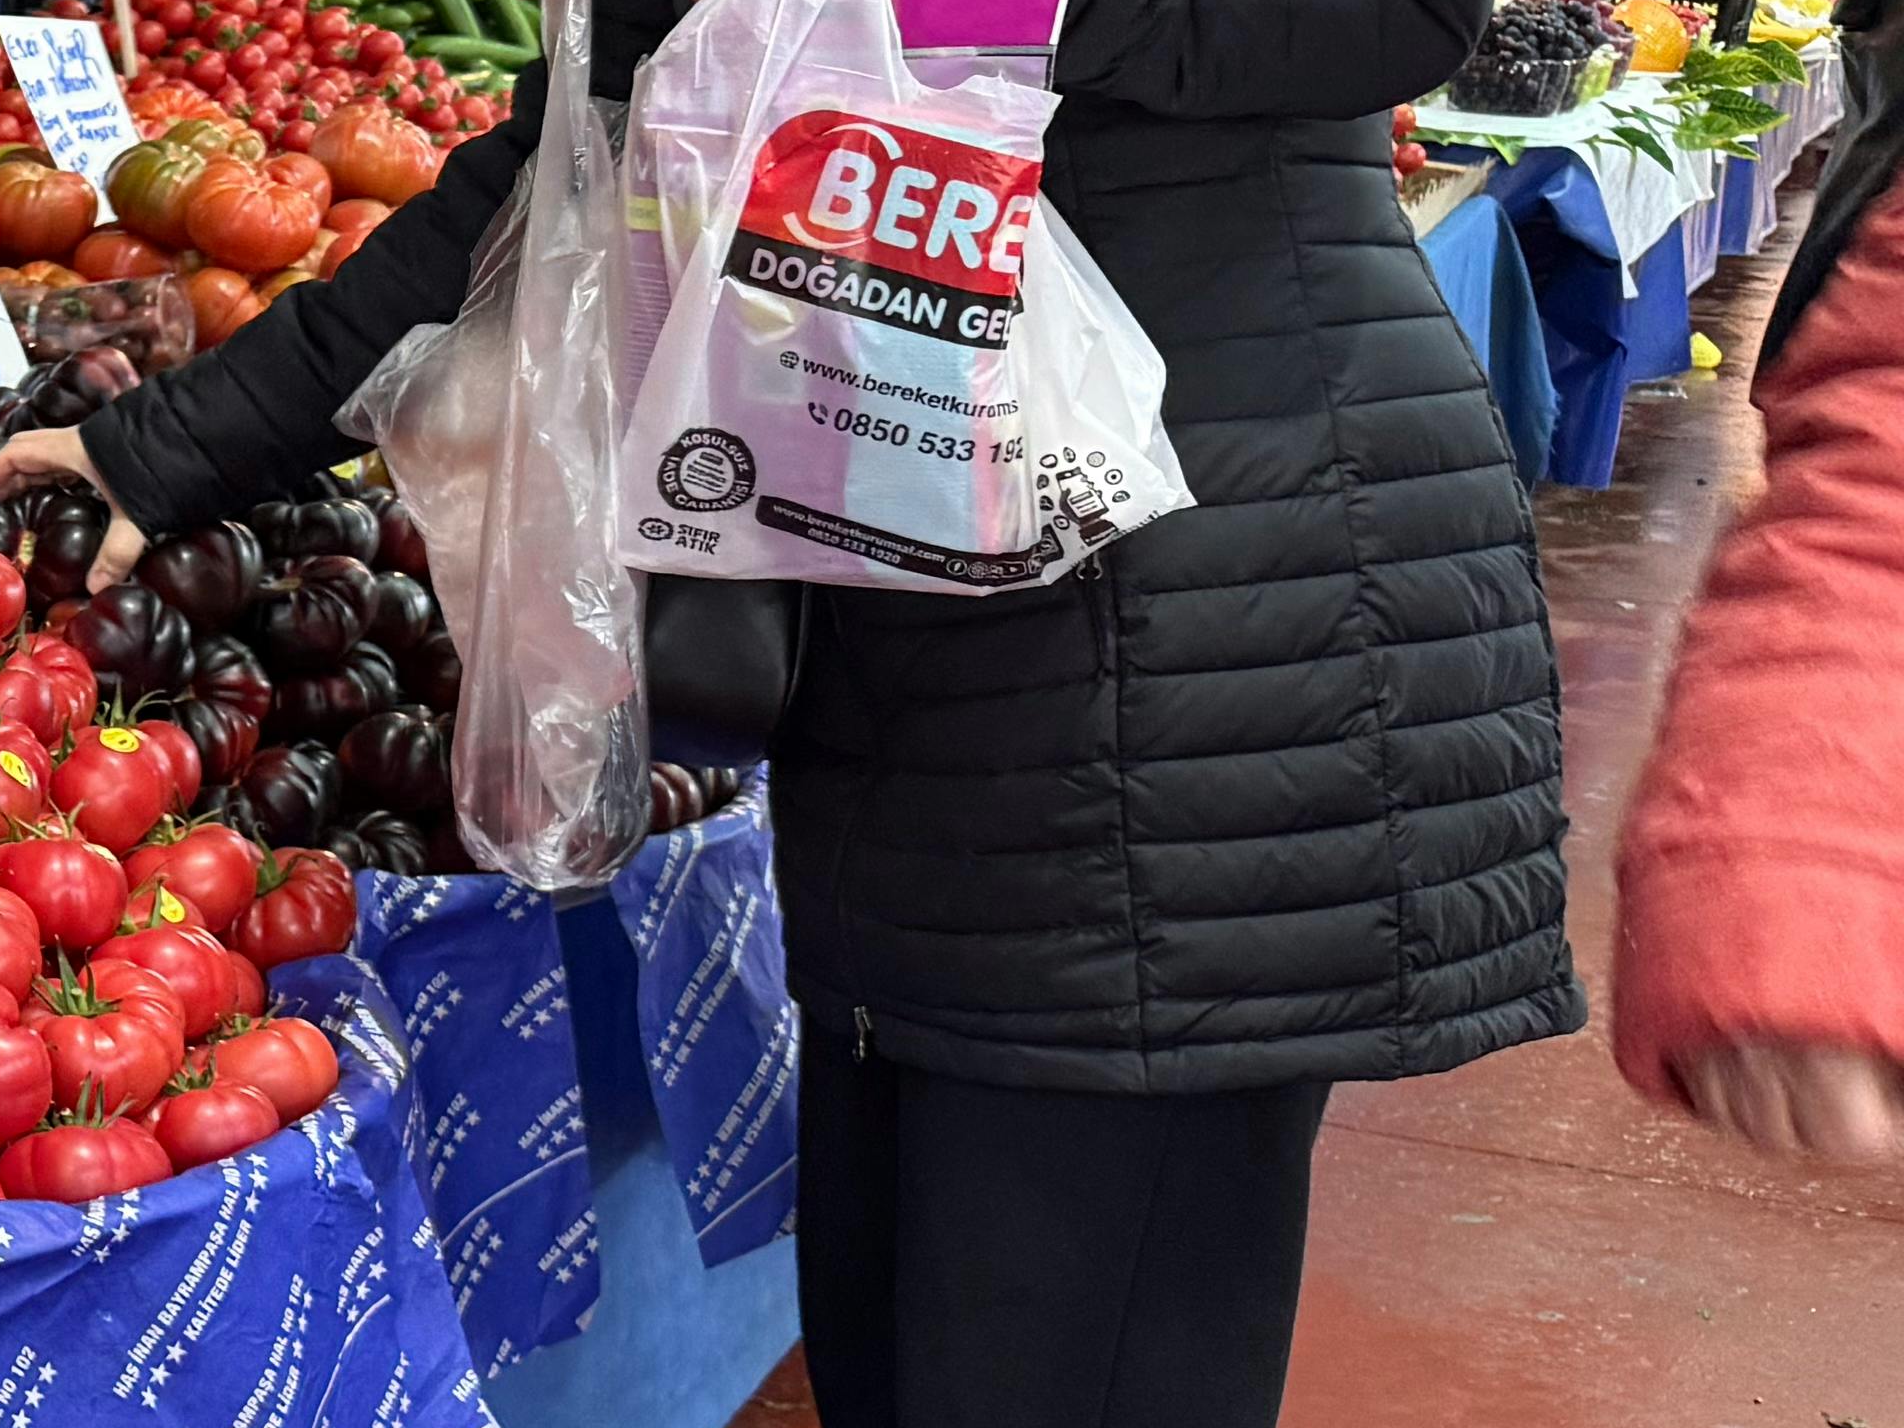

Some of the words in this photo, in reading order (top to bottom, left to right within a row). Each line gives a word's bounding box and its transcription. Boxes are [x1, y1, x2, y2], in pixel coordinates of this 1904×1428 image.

[808, 148, 1033, 274] BERE
[750, 248, 947, 329] DOĞADAN
[834, 408, 909, 446] 0850
[917, 432, 976, 462] 533
[675, 536, 718, 555] ATIK
[677, 524, 720, 543] SIFIR
[218, 1189, 239, 1223] HAL
[157, 1224, 227, 1327] BAYRAMPAŞA
[182, 1266, 236, 1343] KALİTEDE
[225, 1219, 254, 1271] LİDER
[127, 1322, 162, 1367] İNAN
[268, 1334, 290, 1369] HAL
[289, 1273, 306, 1306] 102
[10, 1344, 38, 1378] 102
[112, 1363, 143, 1400] HAS
[275, 1365, 303, 1416] LİDER
